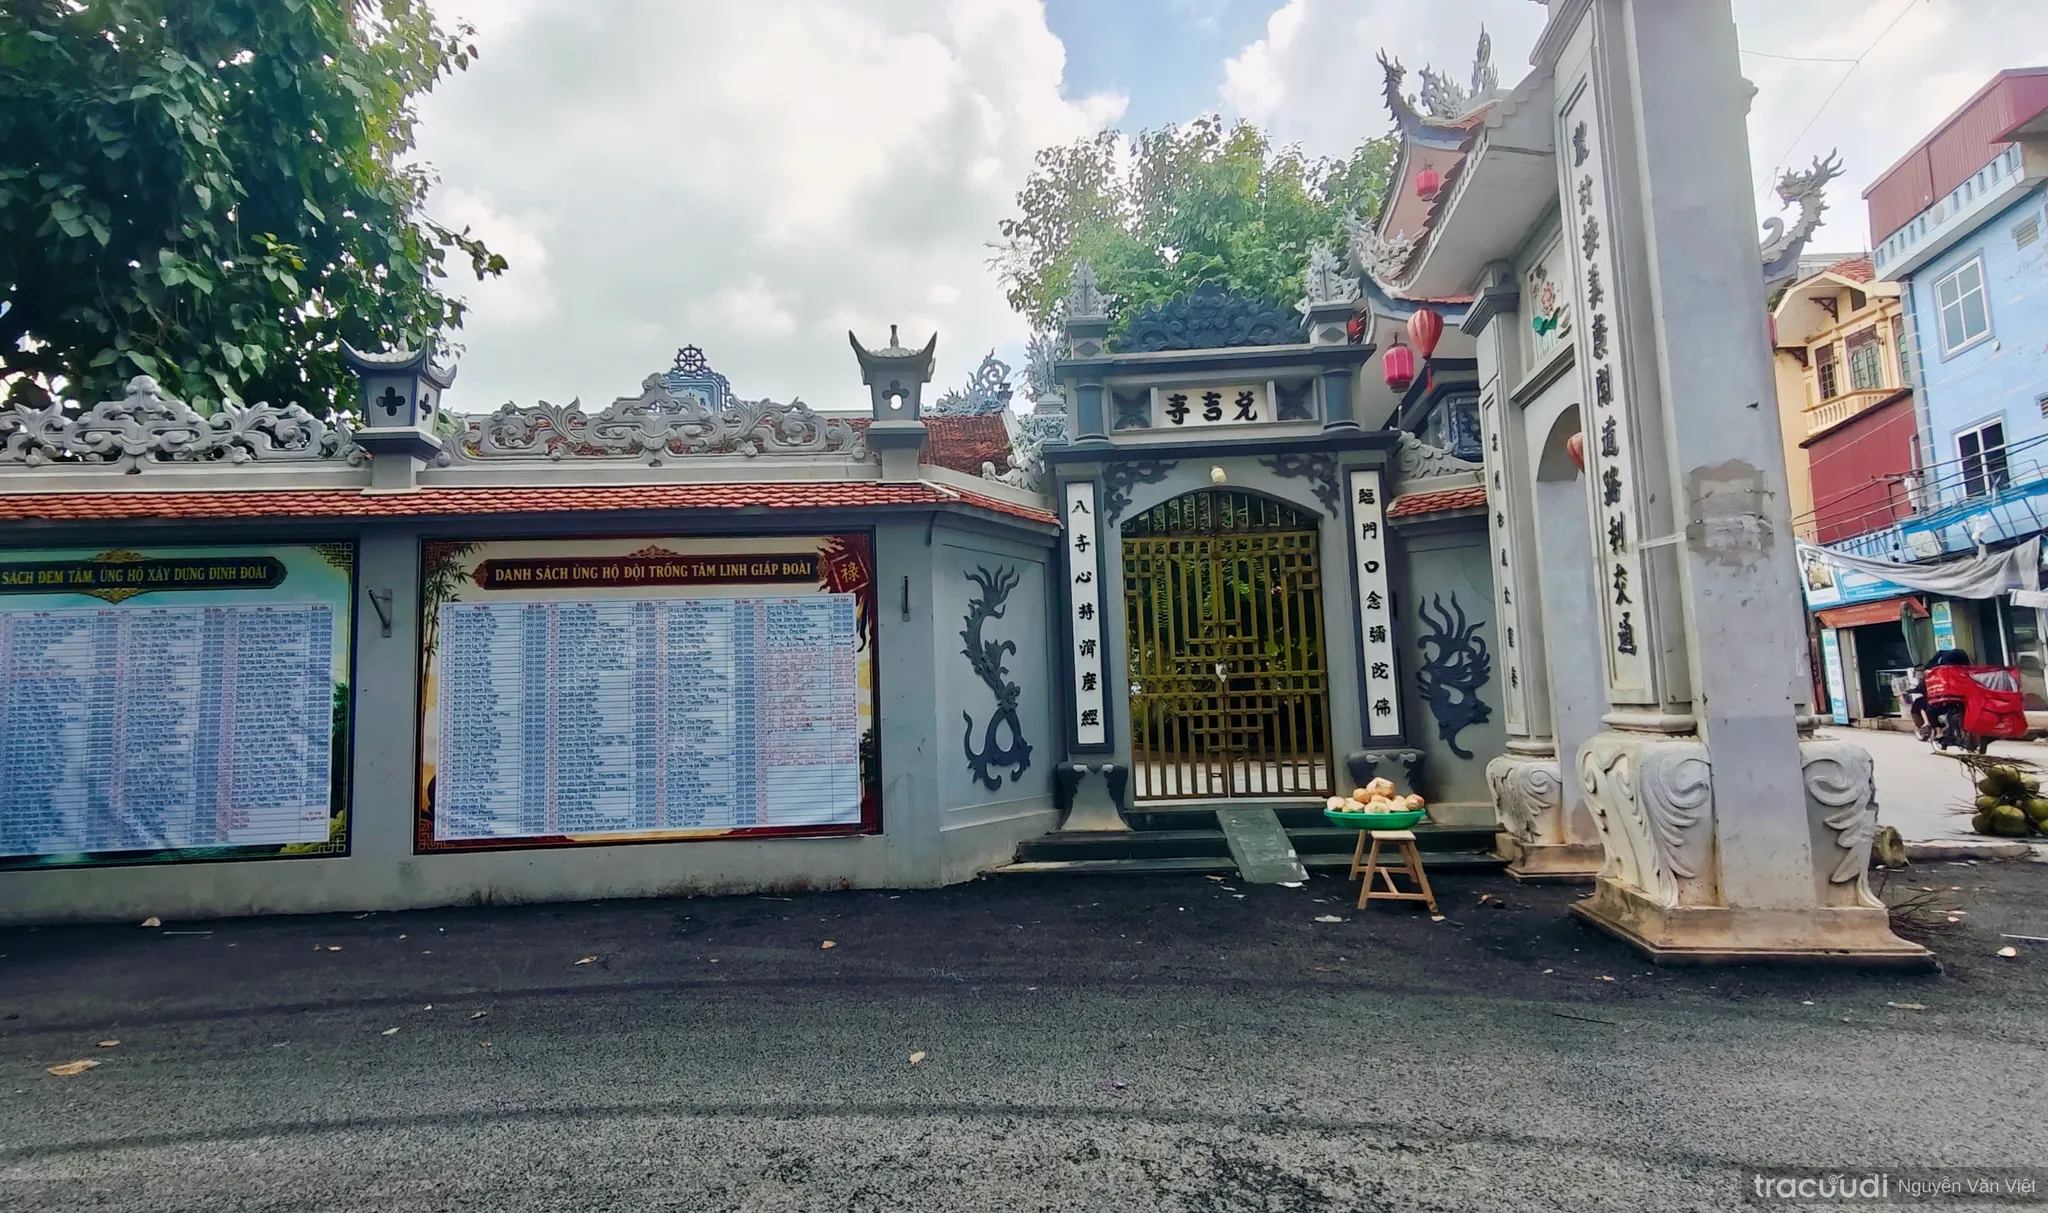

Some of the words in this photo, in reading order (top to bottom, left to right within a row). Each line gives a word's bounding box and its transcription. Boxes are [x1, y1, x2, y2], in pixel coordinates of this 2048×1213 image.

[127, 565, 144, 585] HỘ
[147, 565, 170, 581] XÂY
[495, 568, 532, 581] DANH
[535, 565, 568, 580] SÁCH
[602, 564, 620, 582] HỘ
[624, 563, 645, 582] ĐỘI
[649, 560, 688, 578] TRỐNG
[691, 562, 716, 577] TÂM
[719, 563, 747, 577] LINH
[751, 560, 779, 576] GIÁP
[782, 560, 811, 576] ĐOÀI
